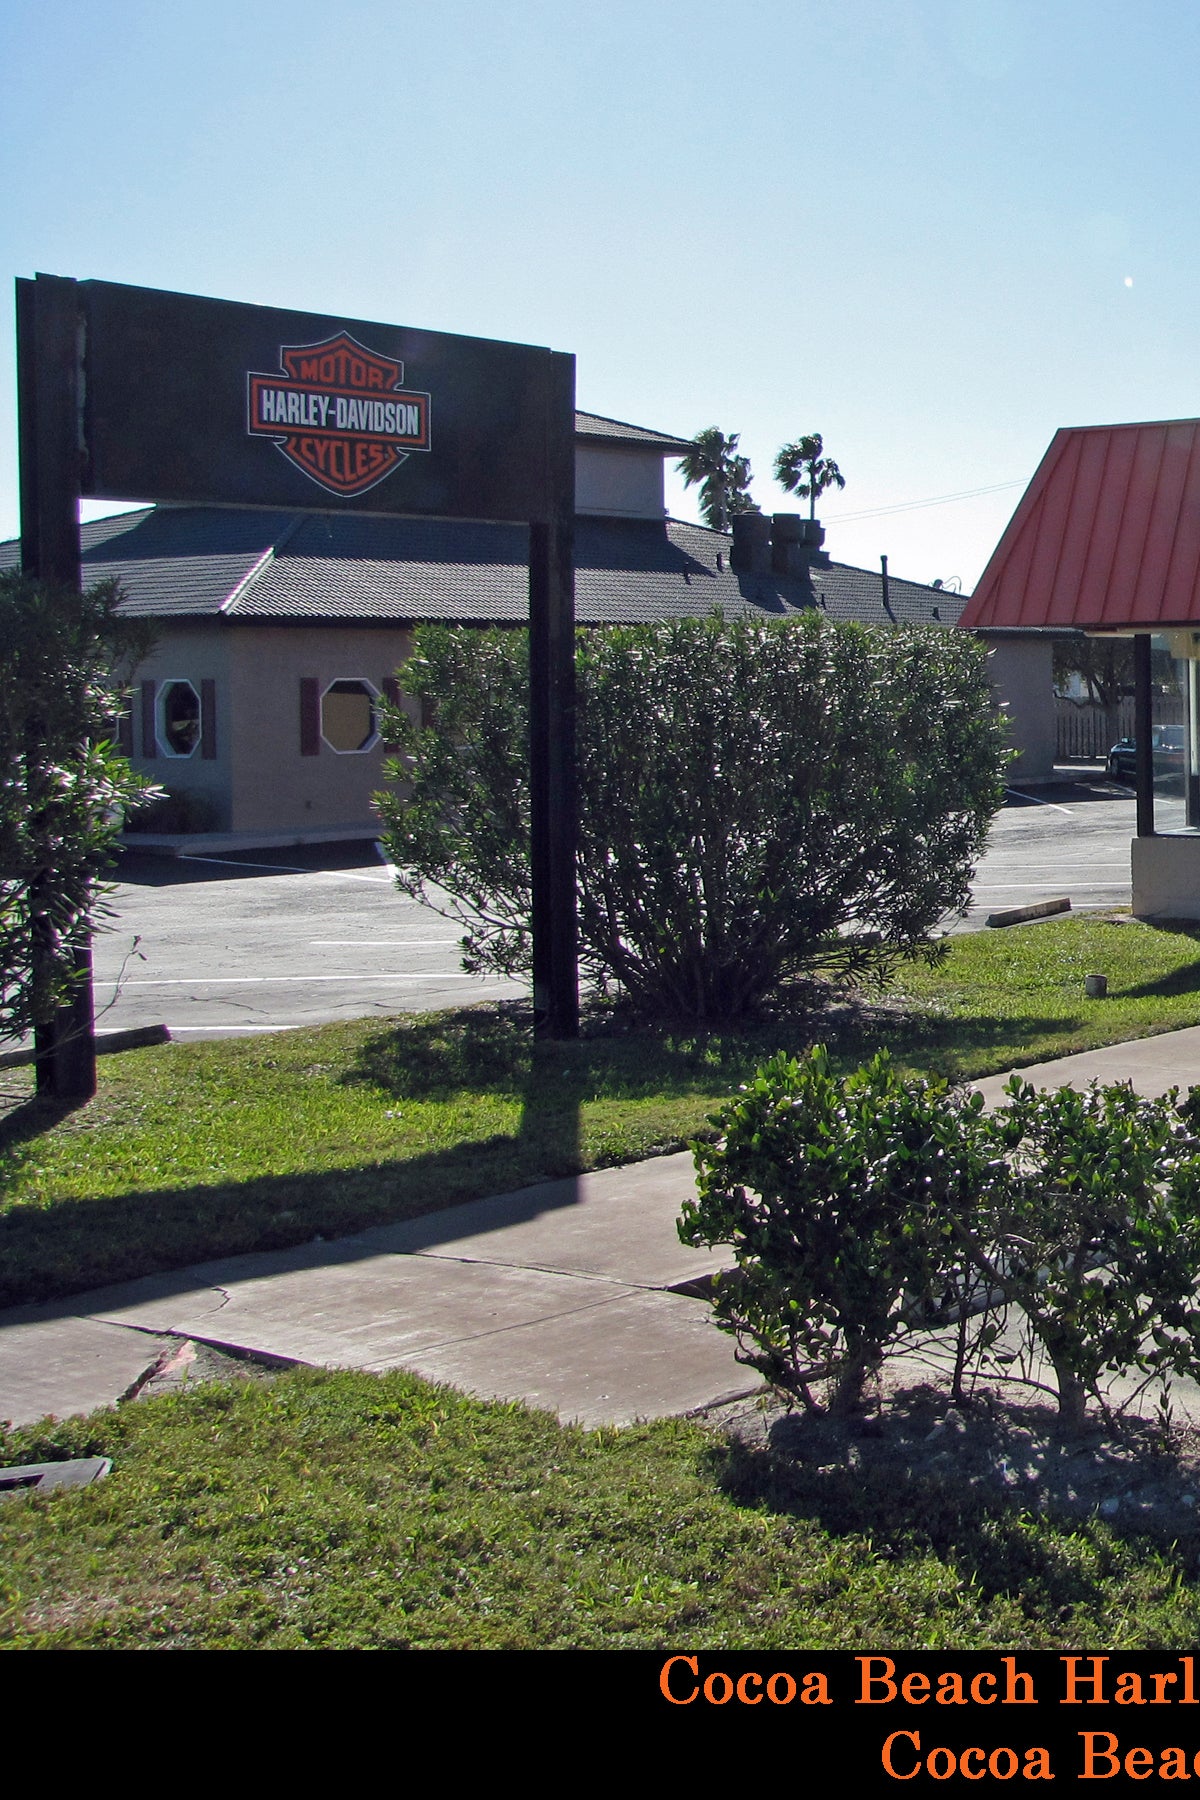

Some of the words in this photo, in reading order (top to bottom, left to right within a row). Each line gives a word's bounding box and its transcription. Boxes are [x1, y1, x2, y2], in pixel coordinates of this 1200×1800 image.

[301, 349, 384, 389] MOTOR
[262, 388, 419, 436] HARLEY-DAVIDSON
[300, 437, 384, 482] CYCLES
